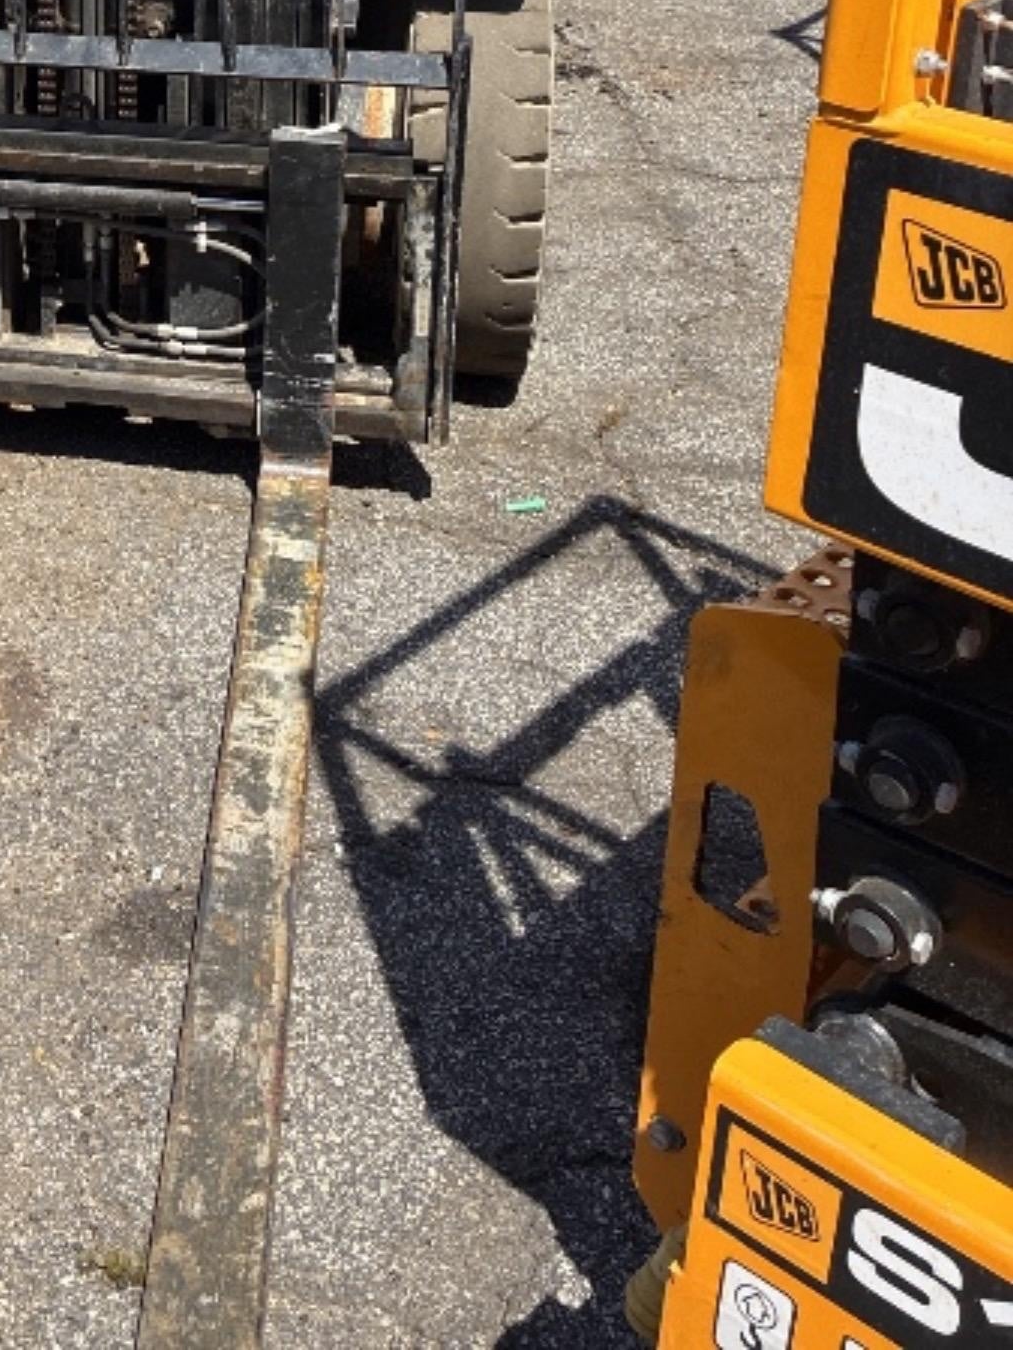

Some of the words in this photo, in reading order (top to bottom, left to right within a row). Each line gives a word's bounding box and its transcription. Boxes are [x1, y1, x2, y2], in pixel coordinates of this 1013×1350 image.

[917, 232, 1000, 304] JCB
[750, 1164, 816, 1237] JCB
[846, 1207, 1013, 1336] S
